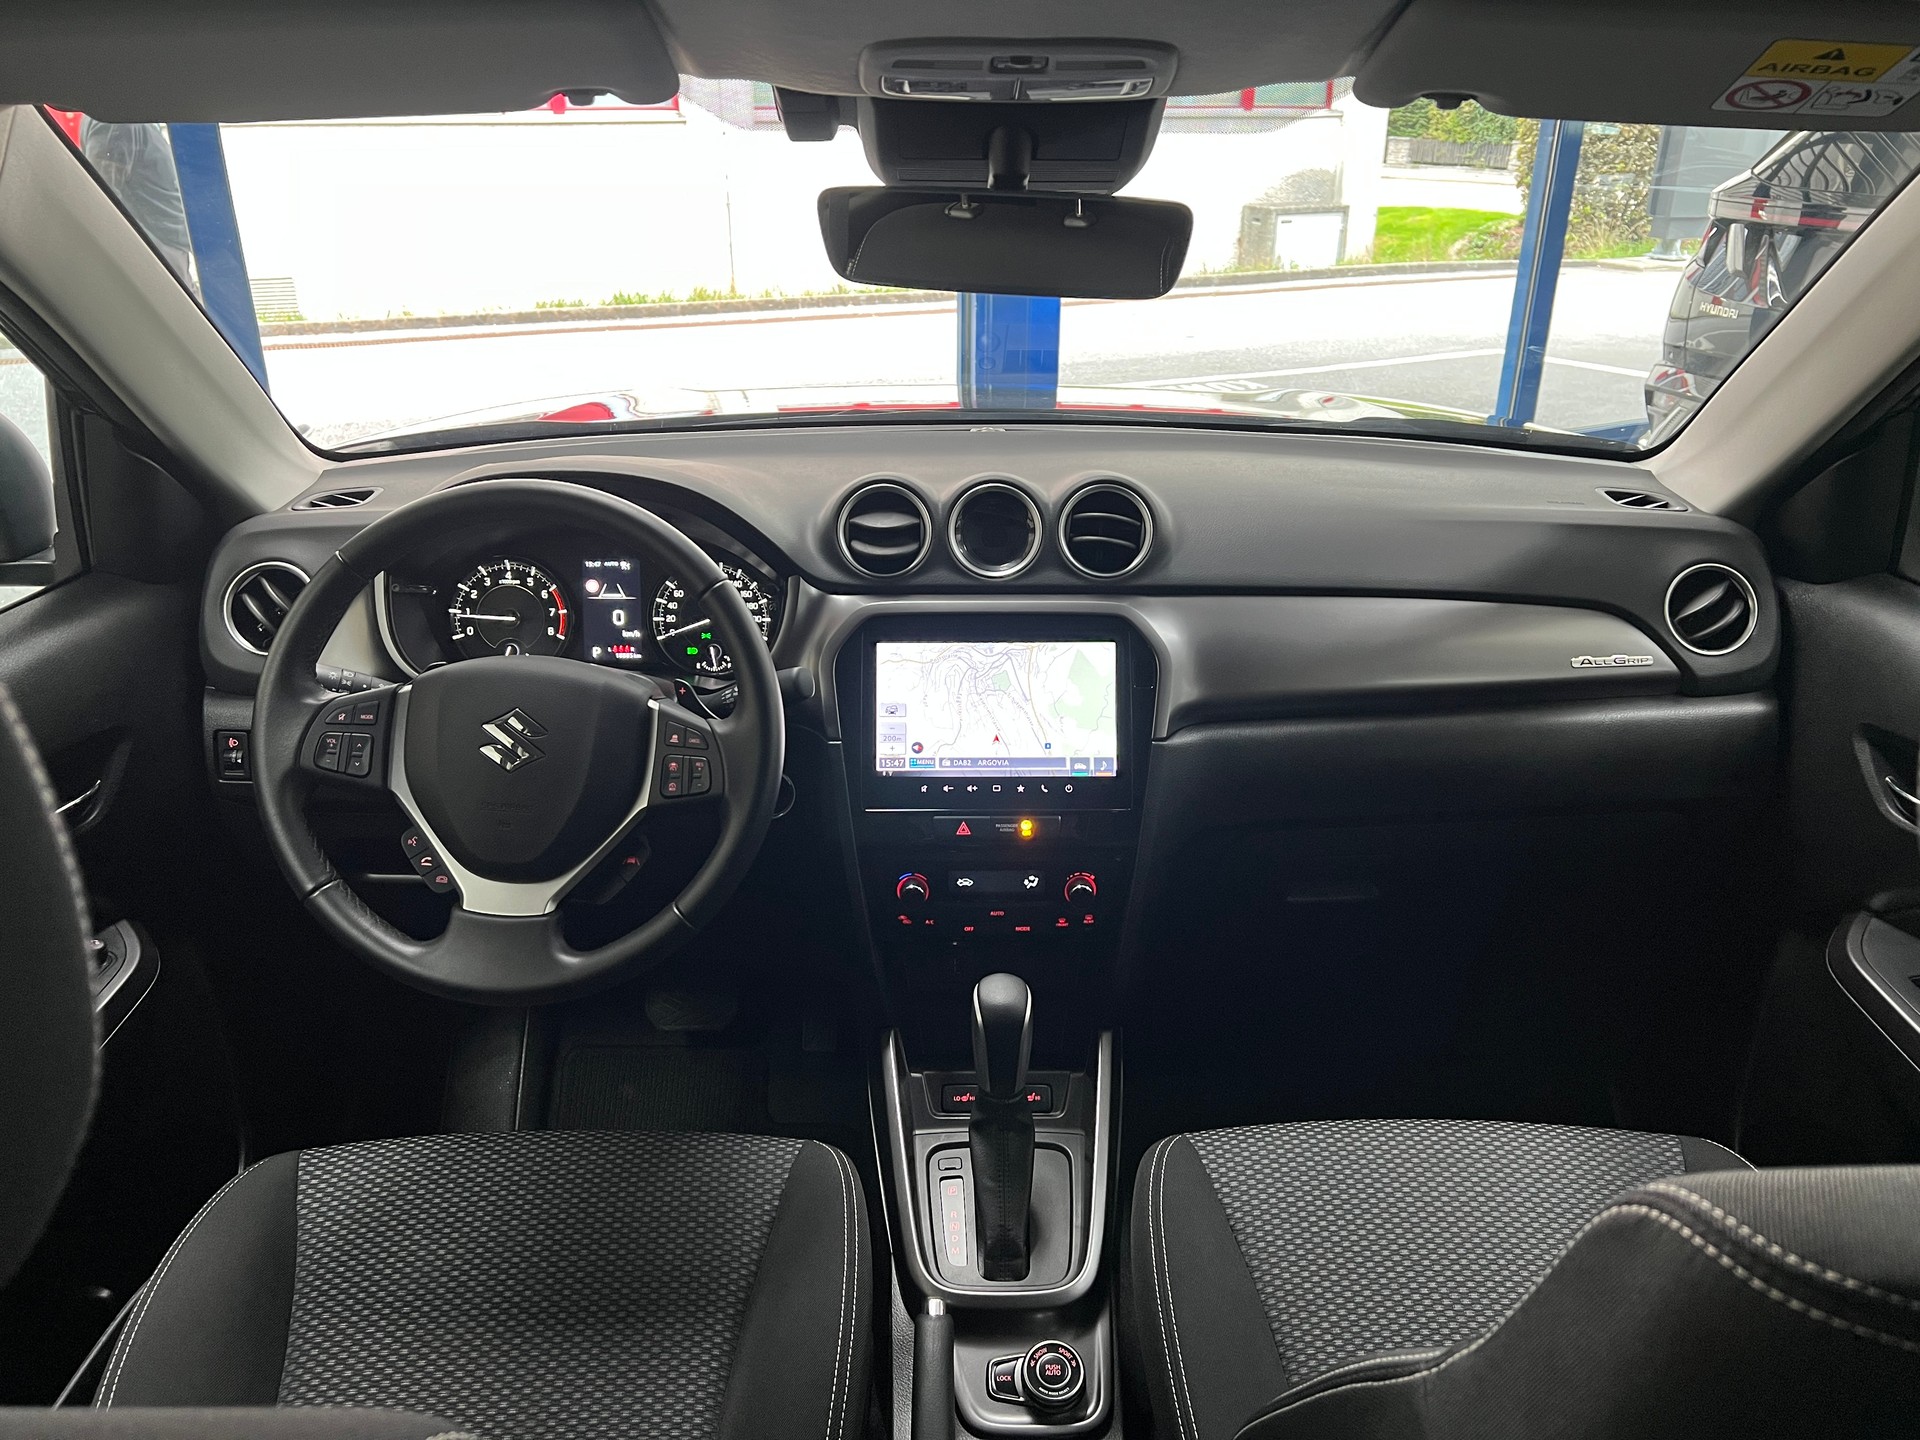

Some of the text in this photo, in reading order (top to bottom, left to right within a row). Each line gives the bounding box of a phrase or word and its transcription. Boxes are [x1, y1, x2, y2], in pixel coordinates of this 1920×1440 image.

[1757, 62, 1877, 77] AIRBAG
[1699, 302, 1740, 319] HYUNDAI
[505, 571, 512, 579] 4
[483, 578, 491, 586] 3
[527, 578, 534, 586] 5
[470, 590, 478, 598] 2
[541, 590, 548, 598] 6
[549, 608, 555, 616] 7
[612, 609, 625, 626] 0
[666, 615, 676, 623] 20
[466, 627, 474, 635] 0
[547, 627, 554, 635] 8
[622, 630, 641, 638] km/h
[593, 646, 601, 658] P
[951, 1247, 959, 1255] M
[1034, 1347, 1048, 1359] SNOW
[1058, 1347, 1073, 1360] SPORT
